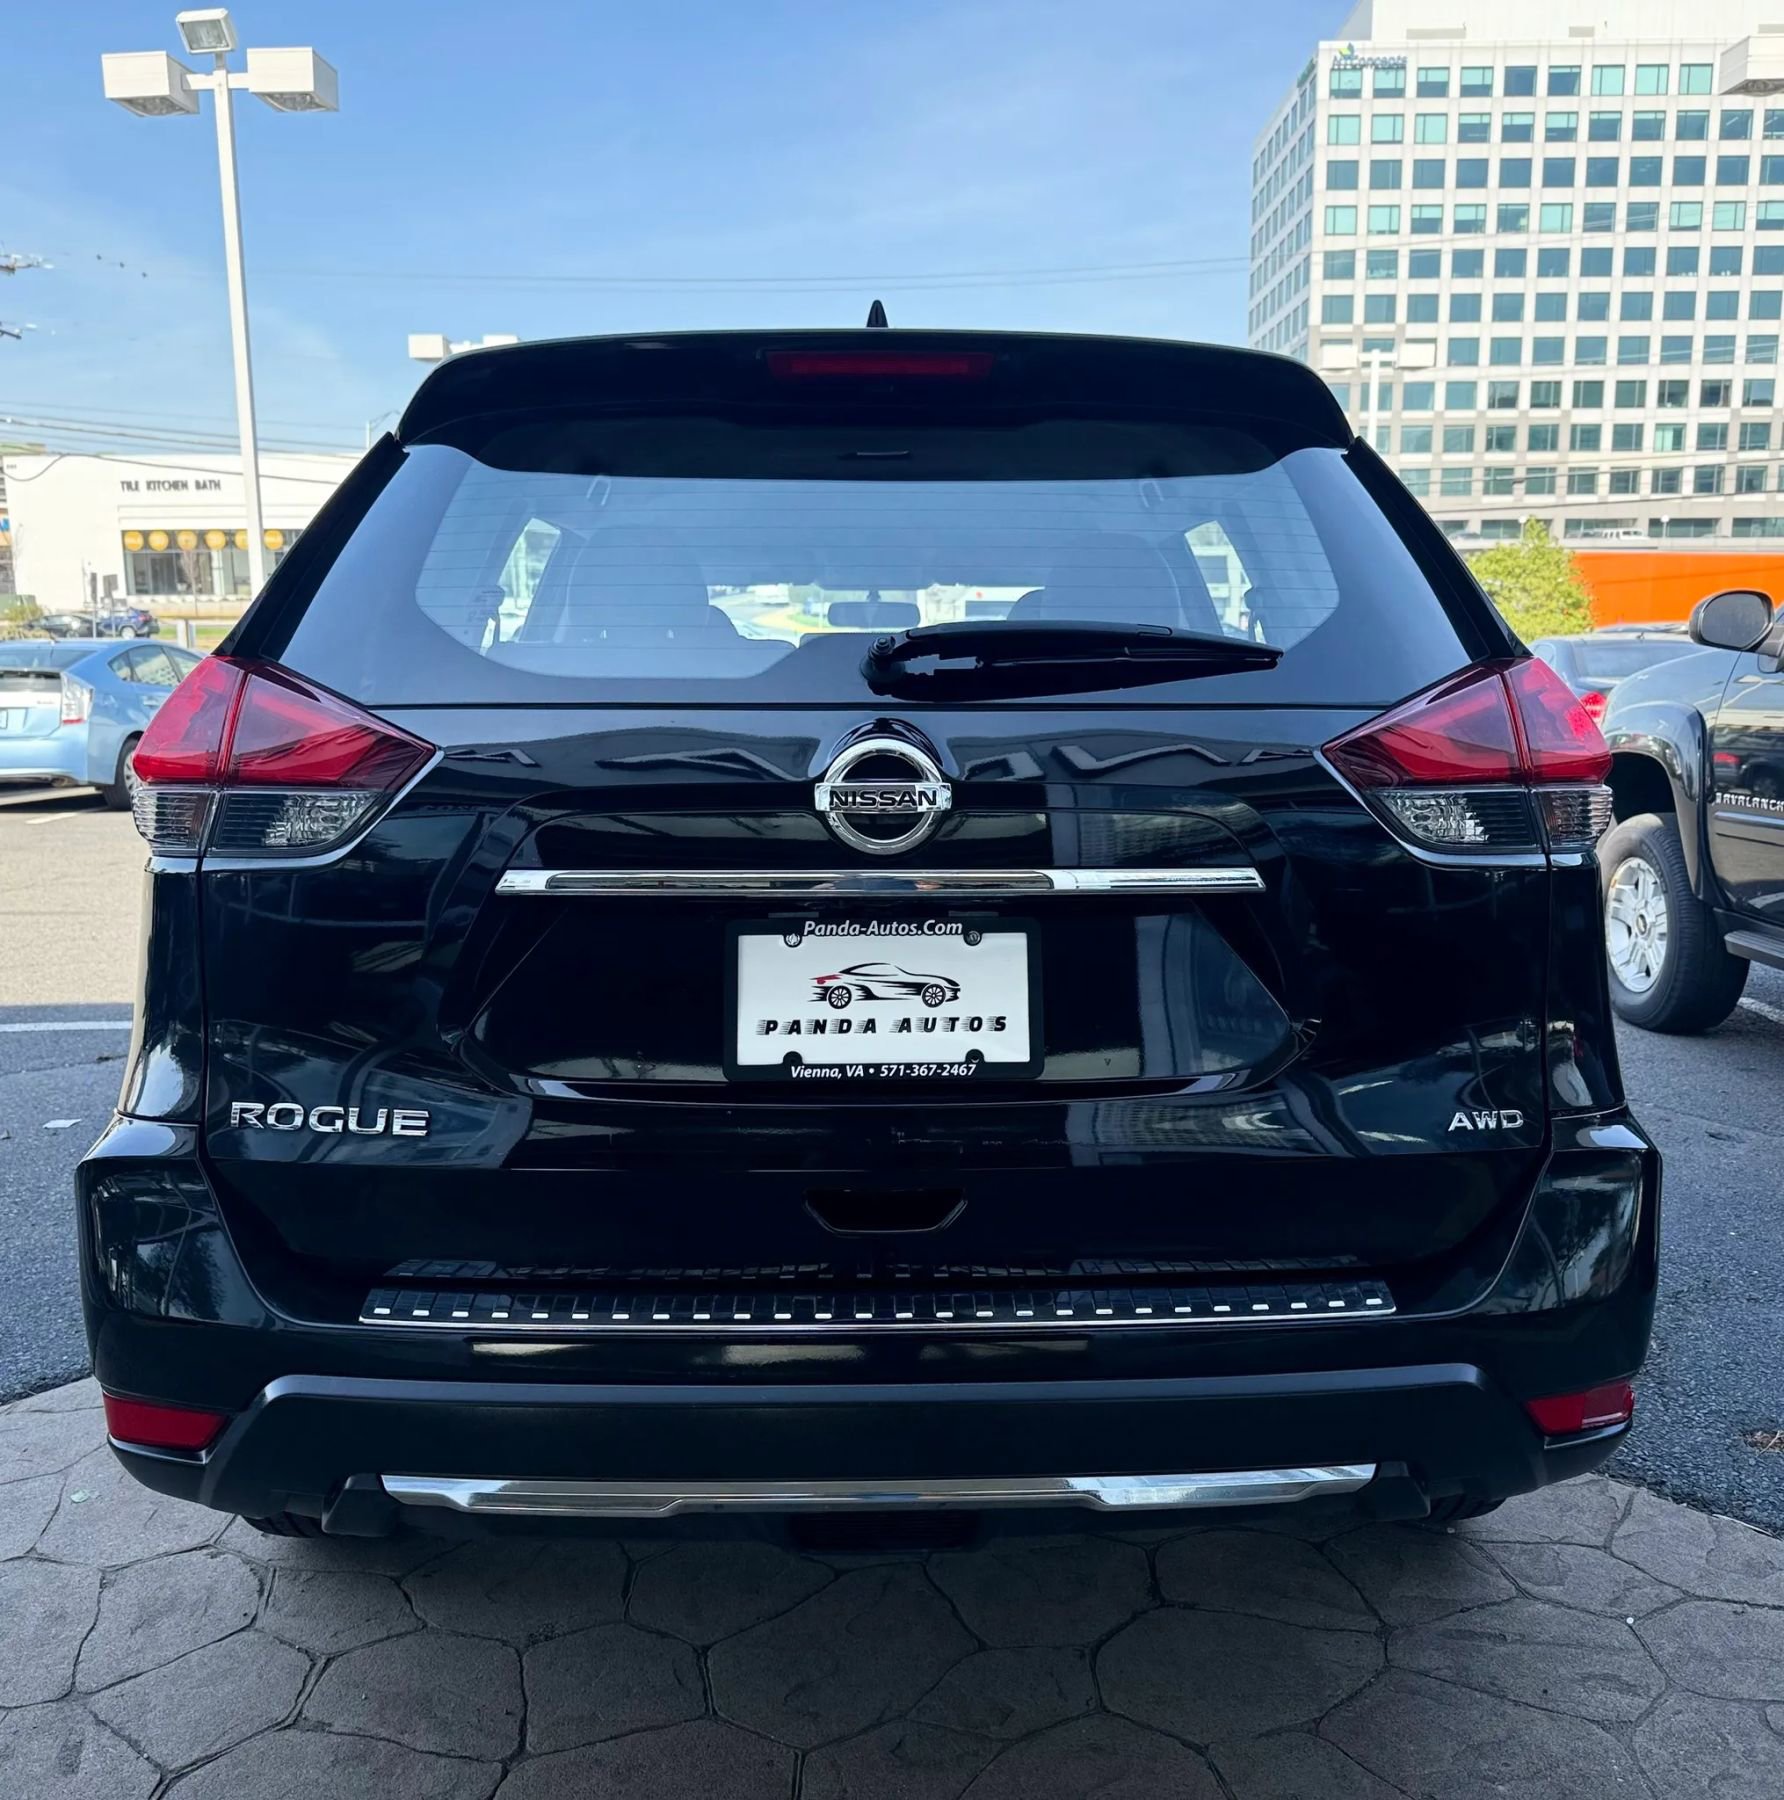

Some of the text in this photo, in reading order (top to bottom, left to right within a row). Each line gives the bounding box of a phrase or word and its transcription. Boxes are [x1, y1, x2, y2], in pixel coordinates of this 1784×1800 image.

[120, 480, 221, 492] TILE KITCHEN BATH
[829, 790, 938, 807] NISSAN
[803, 919, 963, 937] Panda-Autos.Com
[756, 1016, 1007, 1036] PANDA AUTOS
[790, 1063, 977, 1079] Vienna, VA 571-367-2467
[230, 1101, 430, 1136] ROGUE
[1448, 1109, 1524, 1131] AWD
